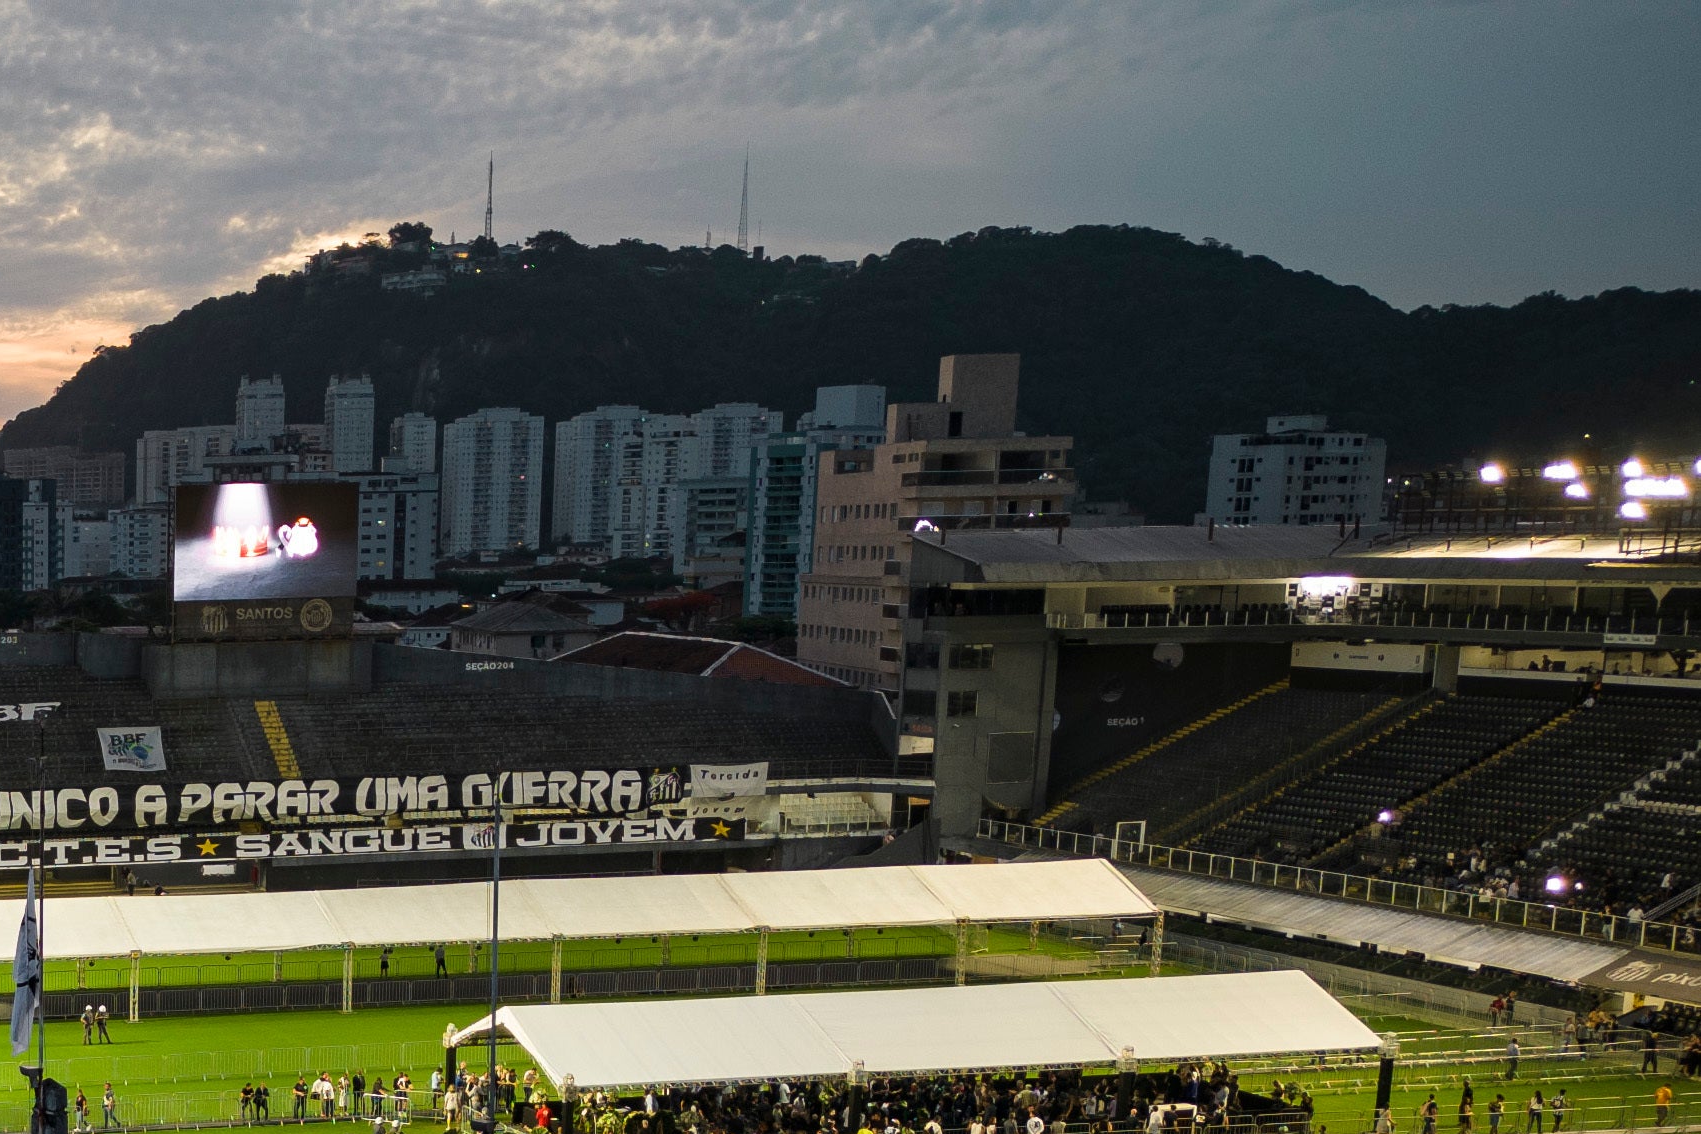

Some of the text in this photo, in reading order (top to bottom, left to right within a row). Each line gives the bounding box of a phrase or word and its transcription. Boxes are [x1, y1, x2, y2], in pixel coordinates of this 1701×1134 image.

[235, 607, 293, 620] SANTOS
[135, 784, 168, 828] A
[177, 779, 340, 824] PARAR
[355, 774, 449, 816] UMA
[461, 770, 642, 813] GUERRA
[236, 826, 451, 858] SANGUE
[516, 819, 696, 847] JOVEM
